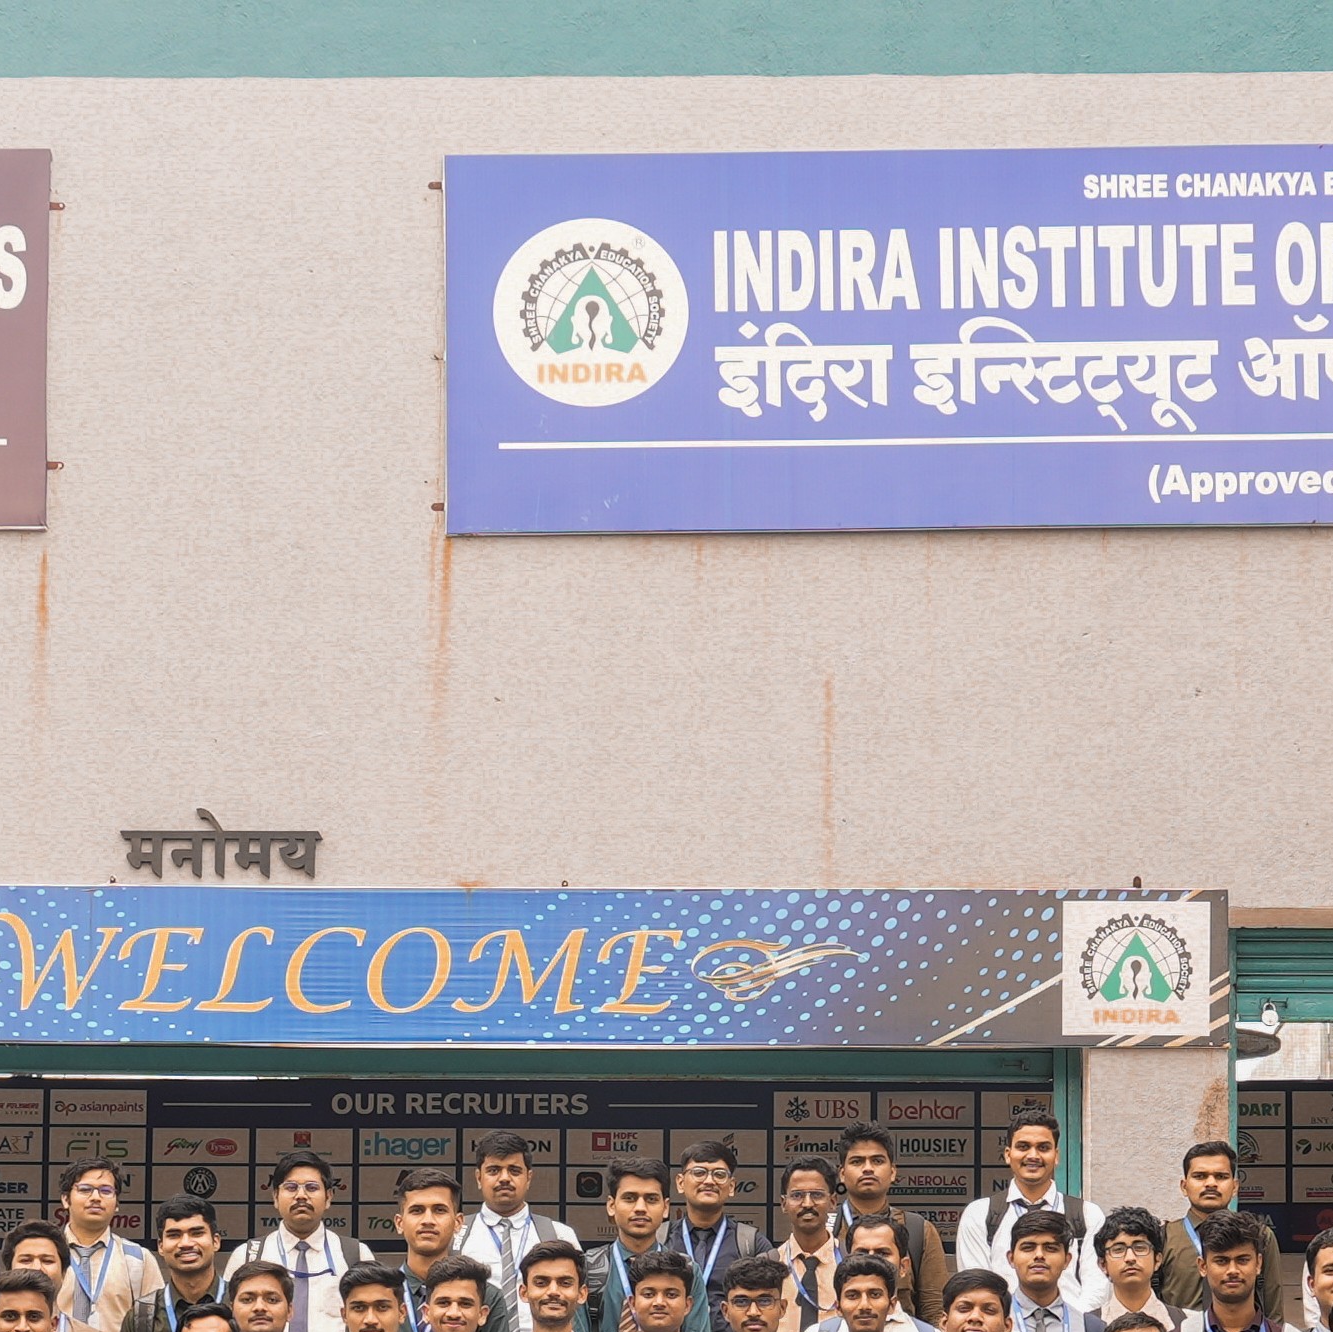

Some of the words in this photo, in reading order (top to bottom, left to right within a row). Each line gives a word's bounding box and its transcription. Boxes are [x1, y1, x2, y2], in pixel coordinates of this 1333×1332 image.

[1084, 174, 1168, 198] SHREE
[1176, 172, 1317, 197] CHANAKYA
[714, 229, 920, 312] INDIRA
[940, 224, 1255, 309] INSTITUTE
[536, 362, 648, 385] INDIRA
[120, 808, 323, 880] मनोमय
[1093, 1009, 1181, 1024] INDIRA
[79, 1102, 144, 1116] asianpaints
[331, 1092, 396, 1115] OUR
[405, 1093, 589, 1115] RECRUITERS
[815, 1100, 860, 1119] UBS
[888, 1099, 966, 1120] behtar
[613, 1132, 638, 1140] HDFC
[899, 1139, 968, 1153] HOUSIEY
[908, 1175, 967, 1186] NEROLAC
